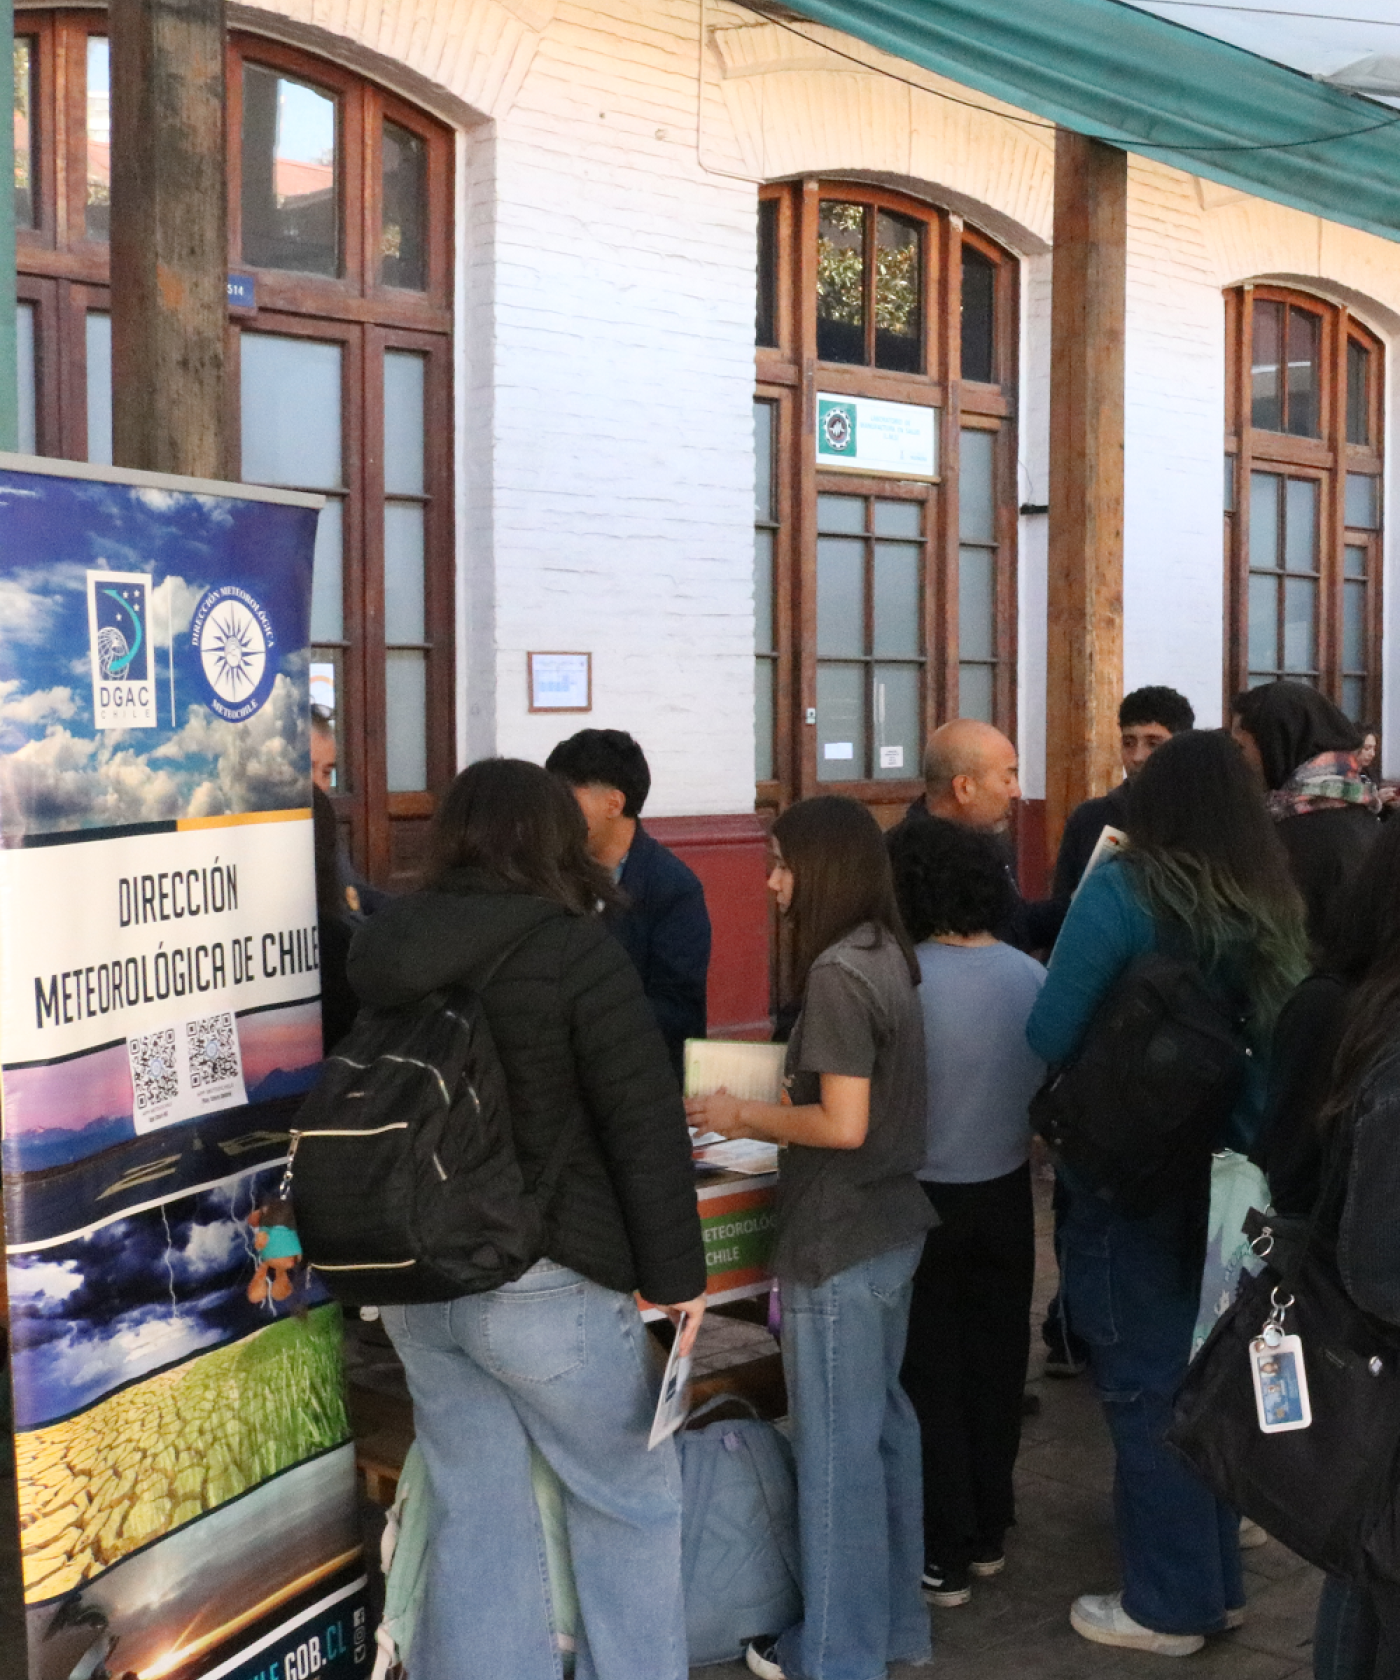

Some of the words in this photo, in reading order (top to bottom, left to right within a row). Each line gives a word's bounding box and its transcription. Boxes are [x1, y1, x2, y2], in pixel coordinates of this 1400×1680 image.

[100, 686, 149, 707] DGAC
[101, 709, 150, 720] CHILE
[118, 855, 239, 928] DIRECCIÓN
[34, 941, 227, 1029] METEOROLÓGICA
[232, 936, 255, 985] DE
[261, 925, 320, 979] CHILE
[705, 1246, 740, 1266] CHILE
